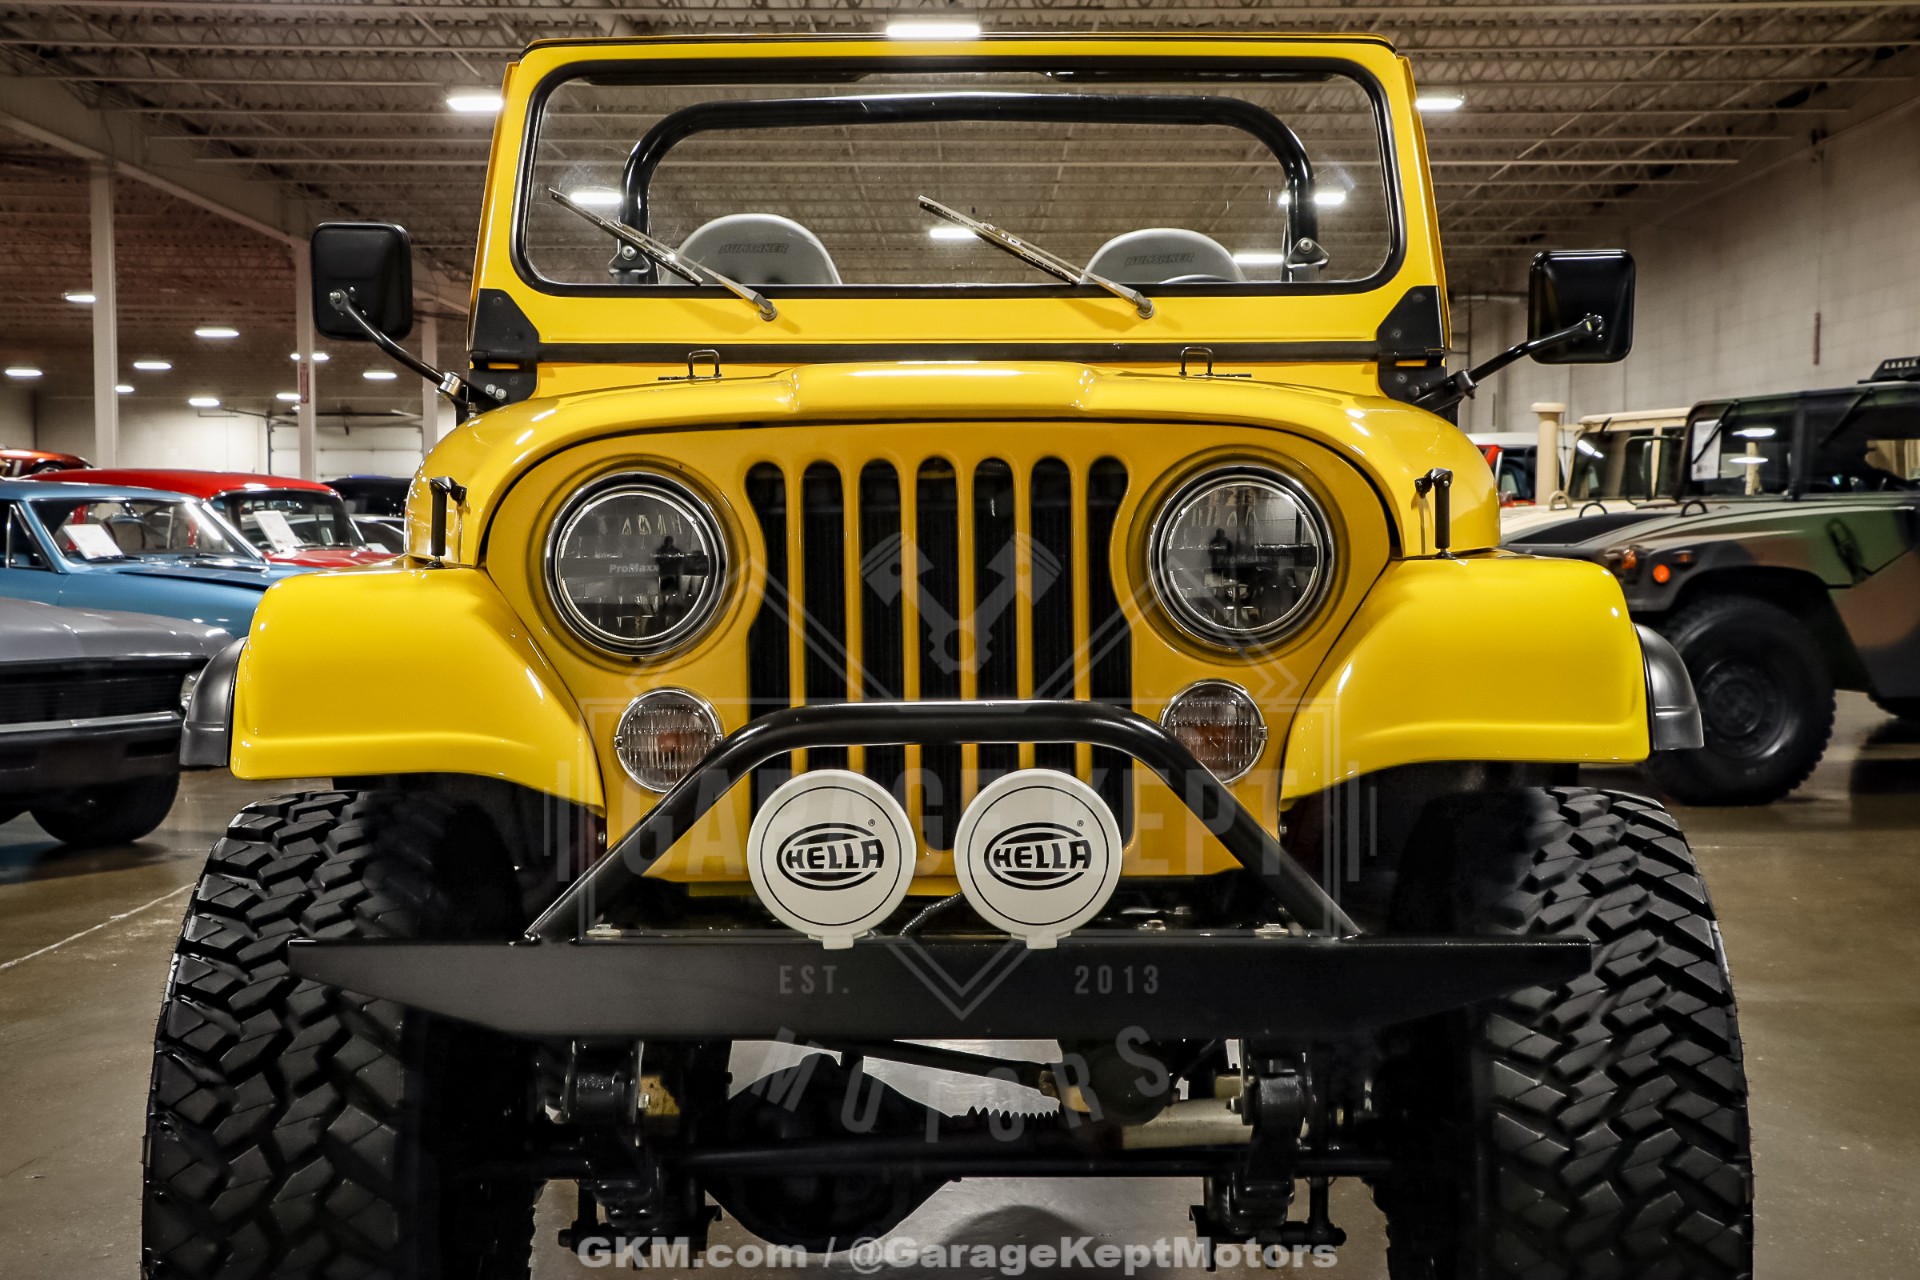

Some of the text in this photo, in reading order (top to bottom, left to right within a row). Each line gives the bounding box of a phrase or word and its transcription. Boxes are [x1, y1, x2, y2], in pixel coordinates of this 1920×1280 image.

[609, 563, 660, 573] ProMaxx
[785, 838, 885, 870] HELLA
[993, 839, 1092, 870] HELLA
